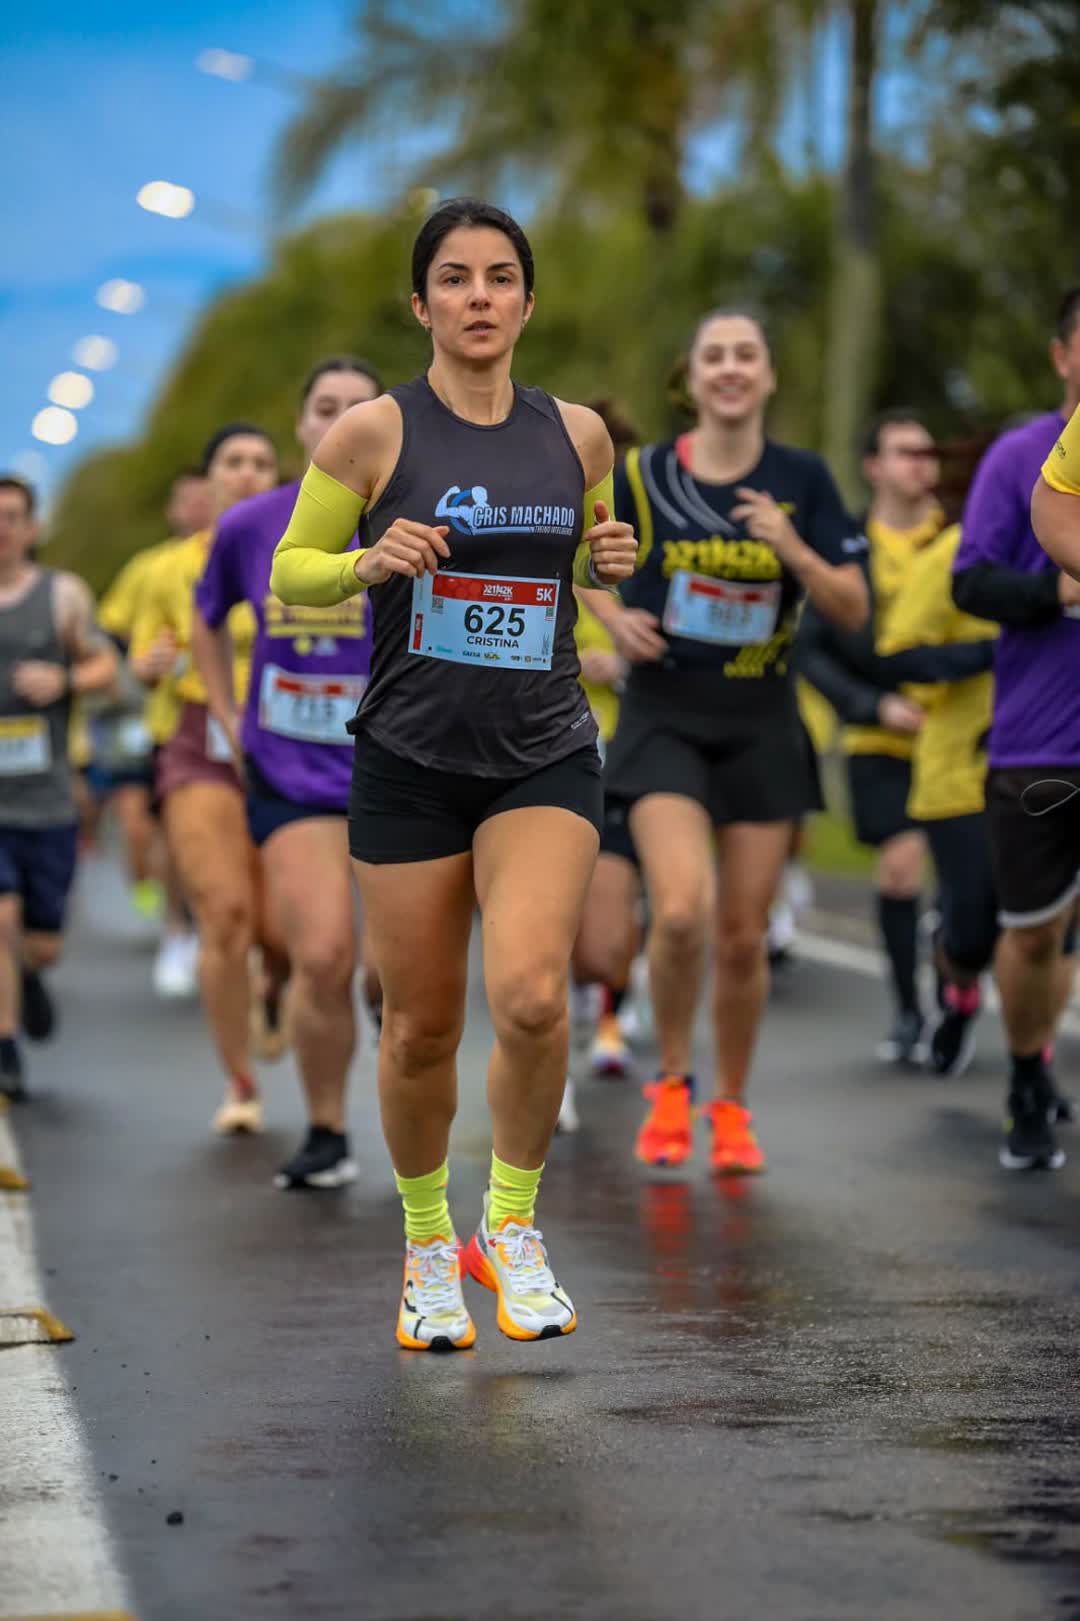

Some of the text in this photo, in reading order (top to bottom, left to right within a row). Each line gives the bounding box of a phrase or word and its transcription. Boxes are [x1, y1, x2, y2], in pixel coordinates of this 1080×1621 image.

[474, 506, 575, 528] CRIS MACHADO
[536, 587, 553, 602] 5K
[464, 604, 526, 637] 625
[466, 636, 520, 648] CRISTINA
